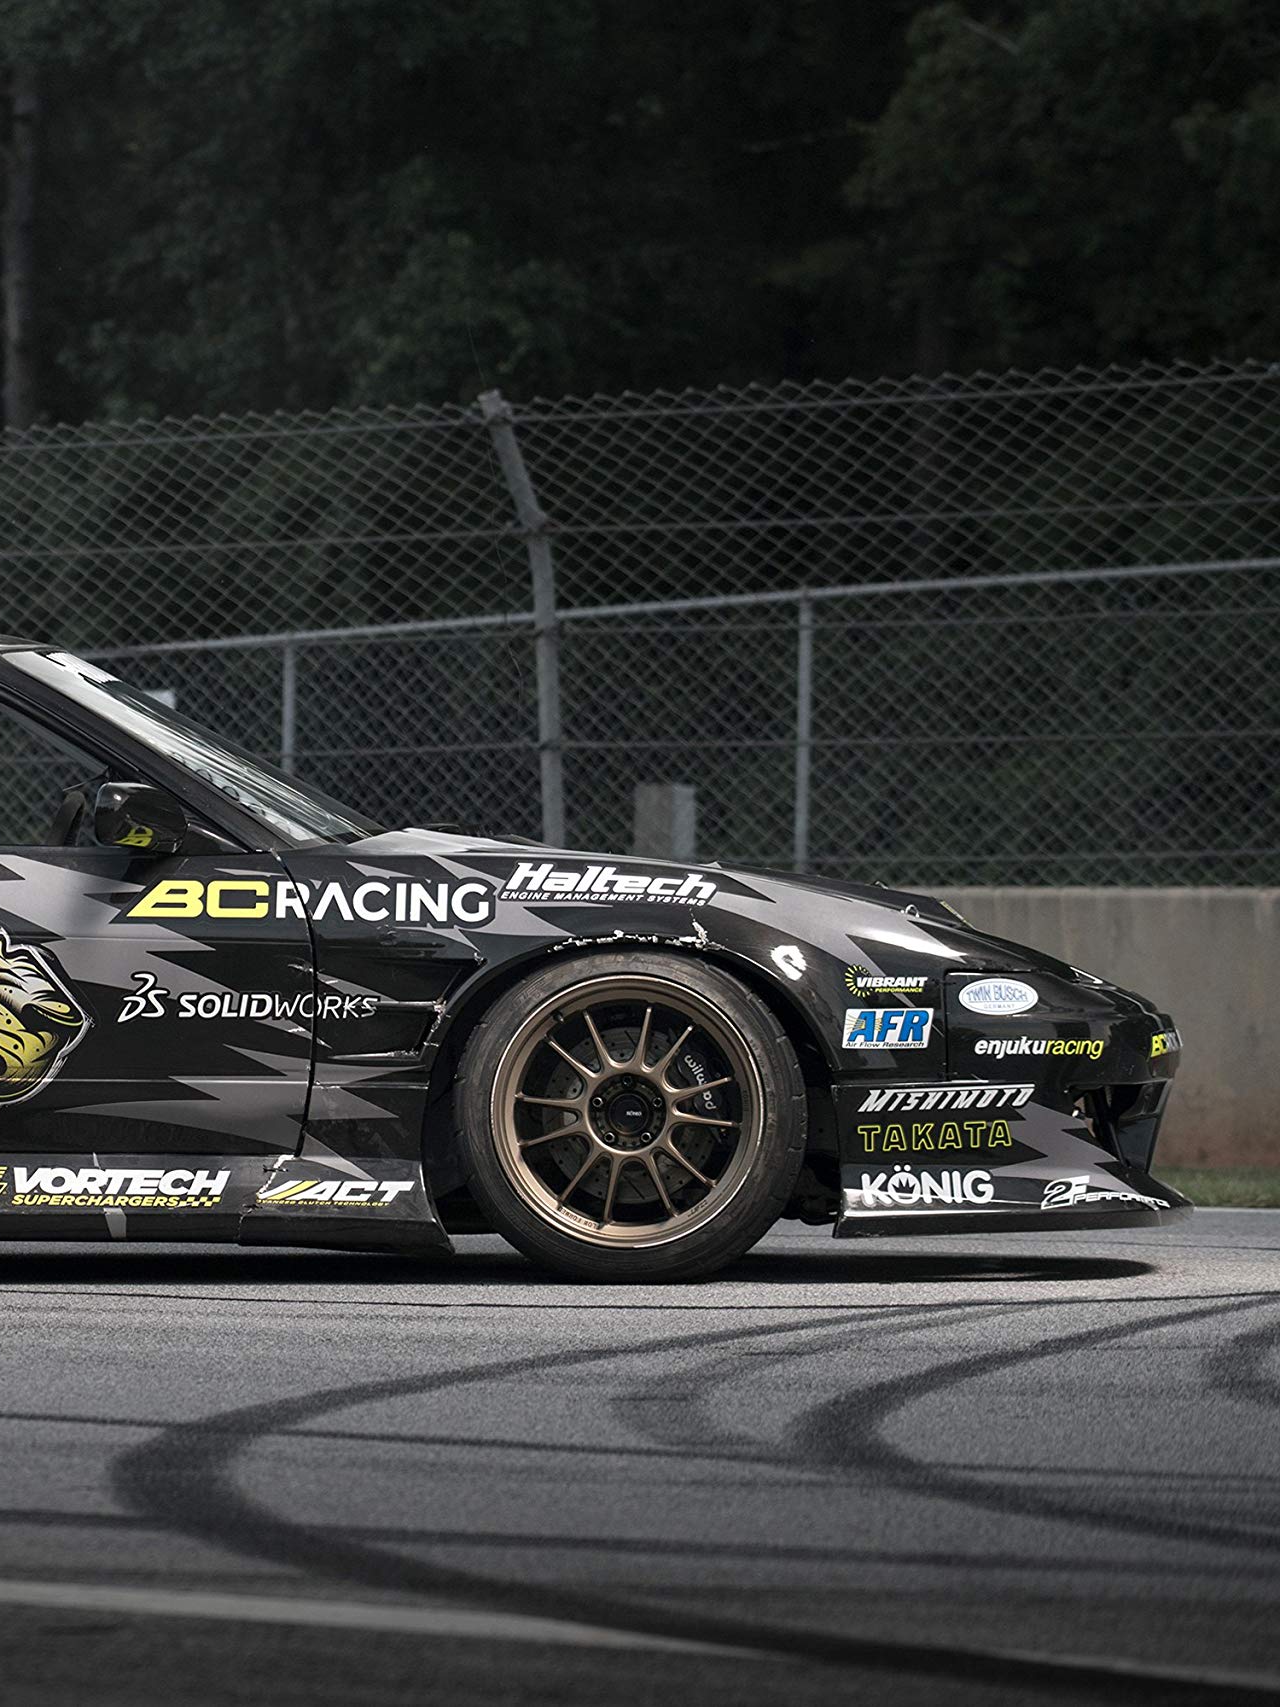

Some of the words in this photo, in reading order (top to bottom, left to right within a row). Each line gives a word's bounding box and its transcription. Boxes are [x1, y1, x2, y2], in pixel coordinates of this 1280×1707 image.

[505, 862, 718, 899] Haltech
[500, 891, 551, 901] ENGINE
[553, 892, 645, 902] MANAGEMENT
[647, 895, 707, 907] SYSTEMS
[856, 976, 928, 988] VIBRANT
[966, 984, 992, 1001] TWIN
[992, 984, 1029, 1001] BUSCH
[178, 993, 378, 1019] SOLIDWORKS
[847, 1010, 930, 1042] AFR
[683, 1054, 717, 1110] wilwod
[857, 1084, 1036, 1113] MISHIMOTO
[857, 1119, 1013, 1152] TAKATA
[13, 1167, 231, 1196] VORTECH
[861, 1164, 995, 1206] KÖNIG
[11, 1194, 180, 1207] SUPERCHARGERS
